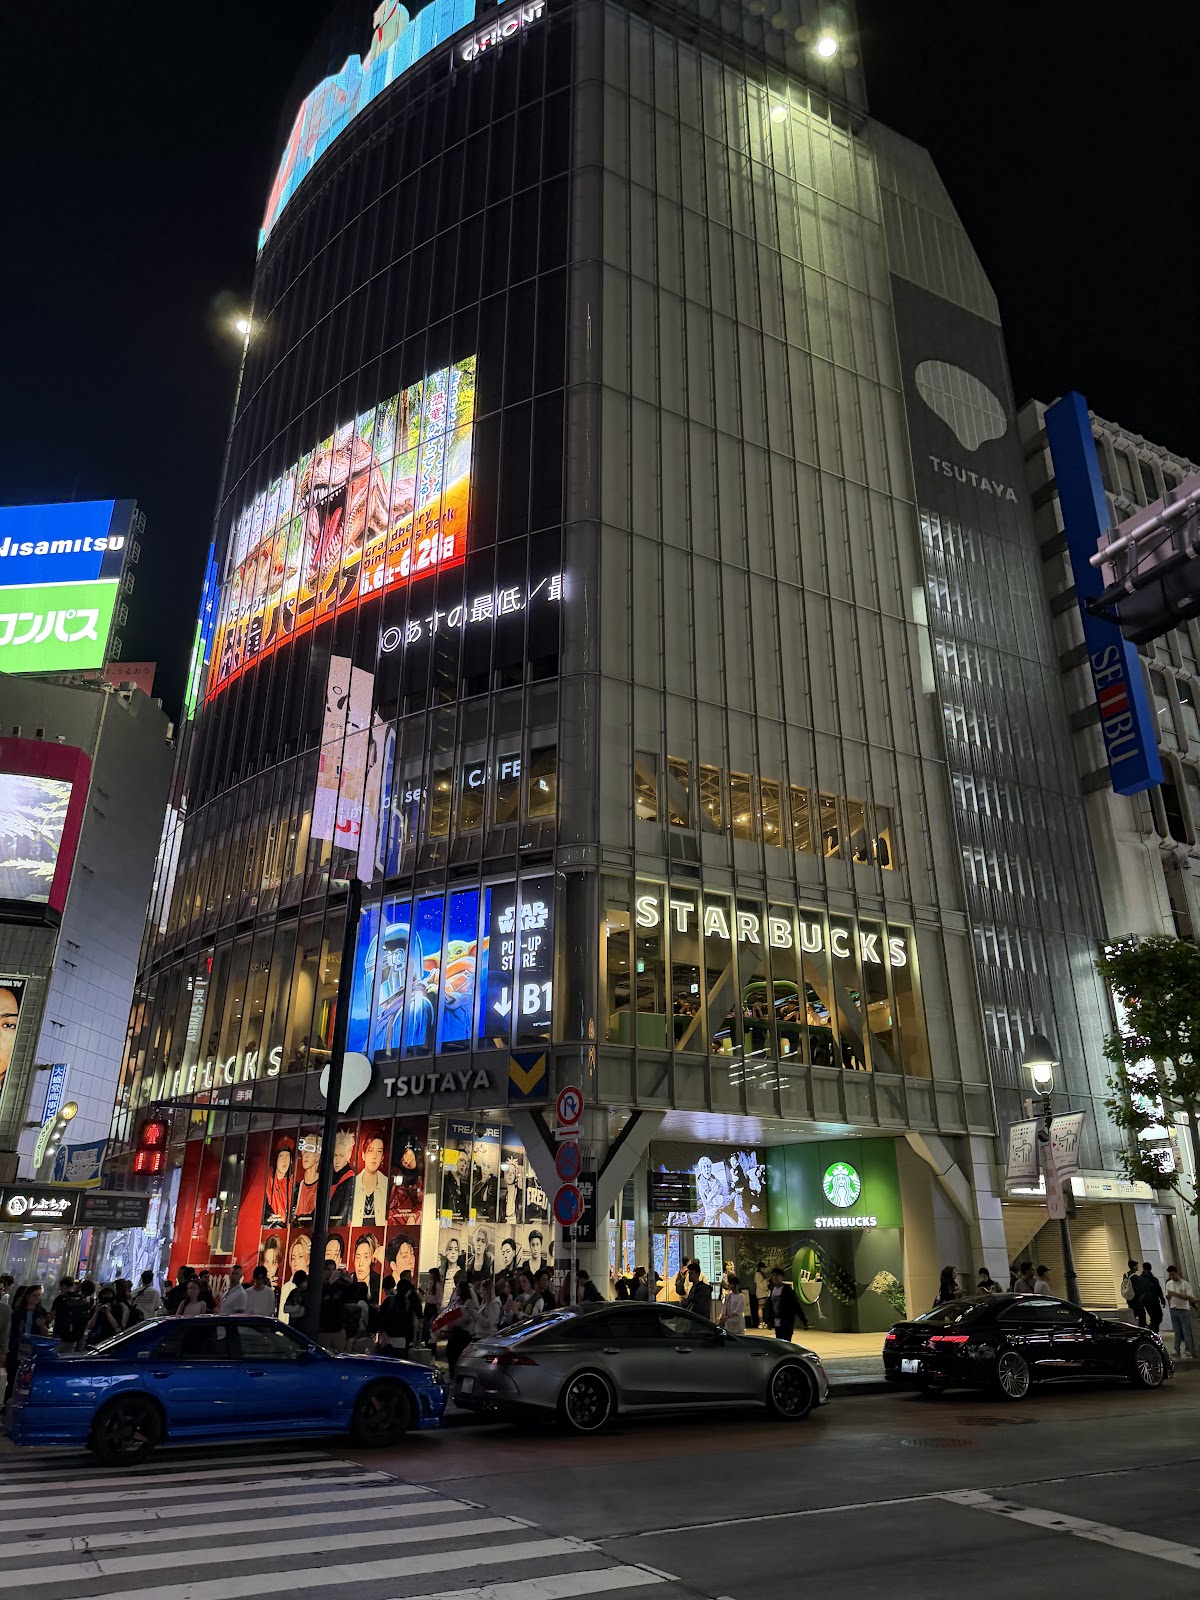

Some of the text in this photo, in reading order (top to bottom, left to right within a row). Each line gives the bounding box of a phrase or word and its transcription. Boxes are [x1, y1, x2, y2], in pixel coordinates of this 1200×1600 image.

[462, 2, 545, 61] QFRONT
[929, 455, 1019, 504] TSUTAYA
[364, 530, 422, 569] Dinosaus
[1091, 645, 1139, 766] SEIBU
[499, 902, 549, 920] SAR
[501, 936, 541, 956] PO-UP
[636, 896, 908, 968] STARBUCKS
[502, 952, 536, 971] STRE
[383, 1069, 490, 1098] TSUTAYA
[452, 1125, 500, 1138] TREURE
[815, 1216, 877, 1228] STARBUCKS
